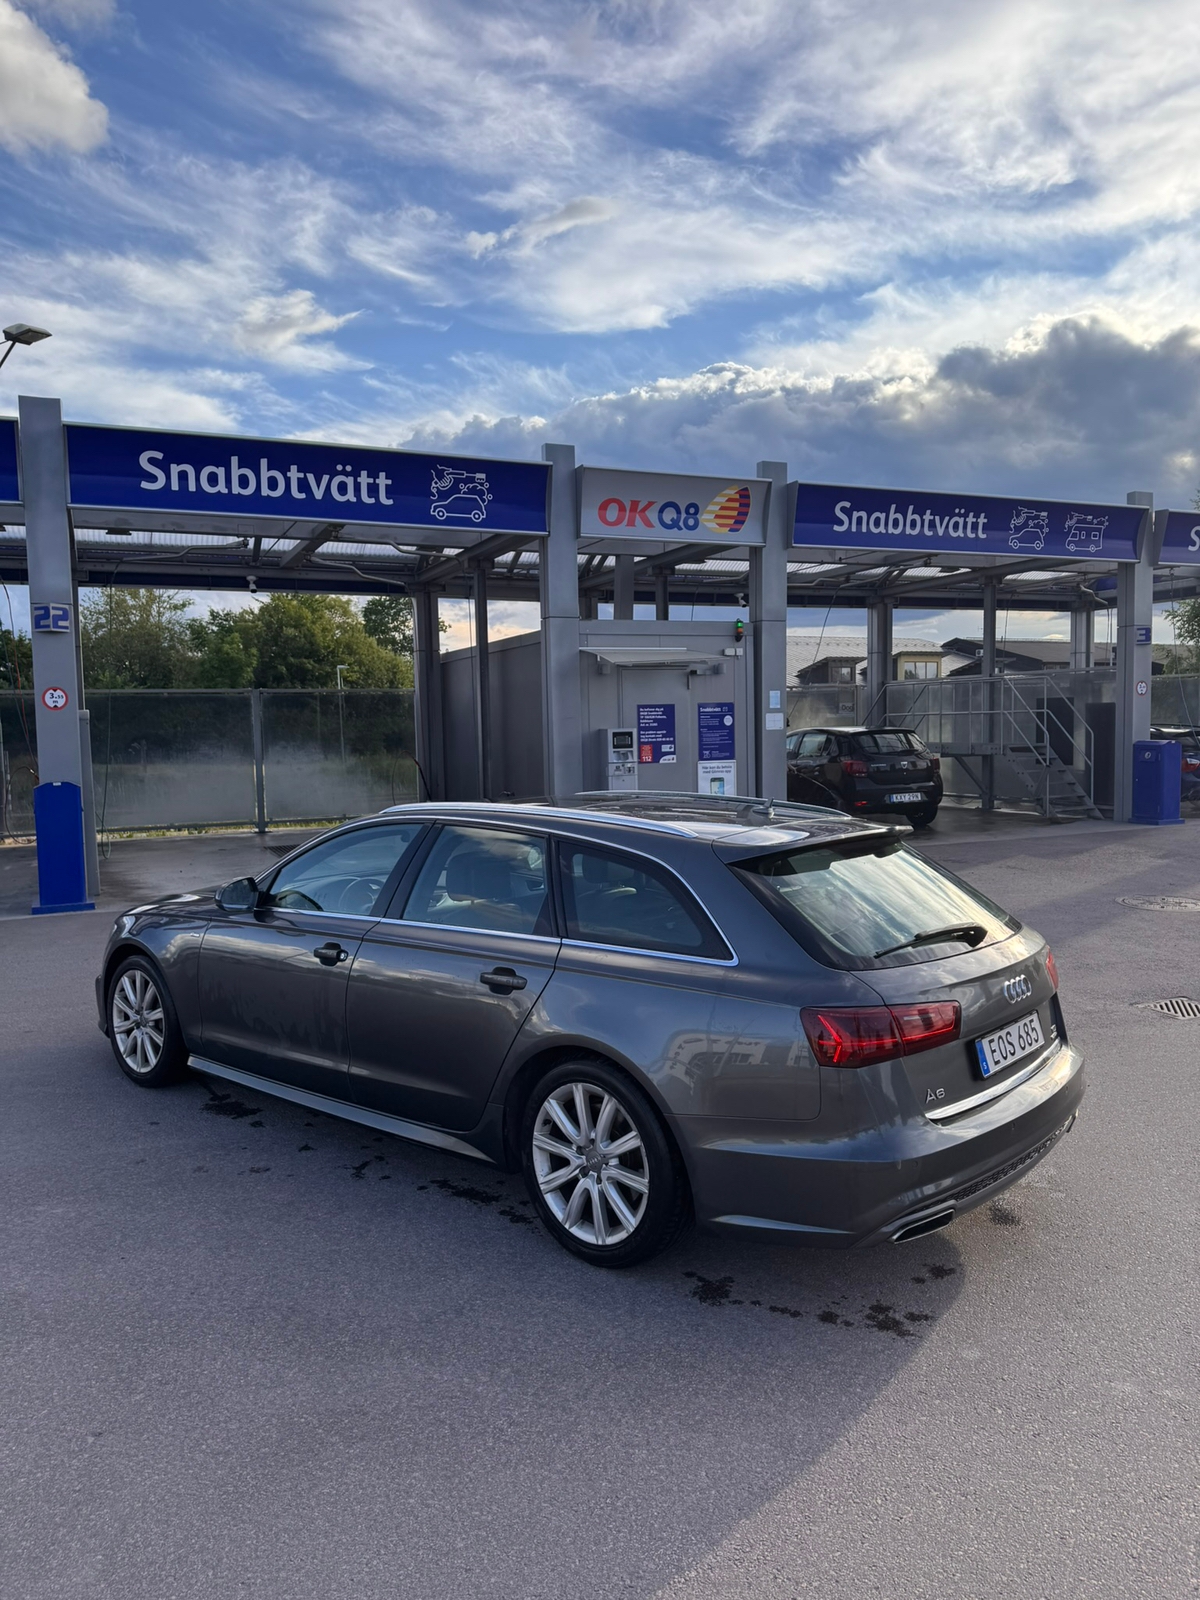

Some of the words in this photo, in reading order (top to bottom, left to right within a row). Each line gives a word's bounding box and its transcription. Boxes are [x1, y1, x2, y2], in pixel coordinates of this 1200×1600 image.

[139, 450, 394, 505] Snabbtvätt
[597, 497, 700, 531] OKQ8
[832, 500, 988, 539] Snabbtvätt
[988, 1030, 1016, 1066] EOS
[1018, 1018, 1039, 1051] 685
[925, 1087, 946, 1104] A6
